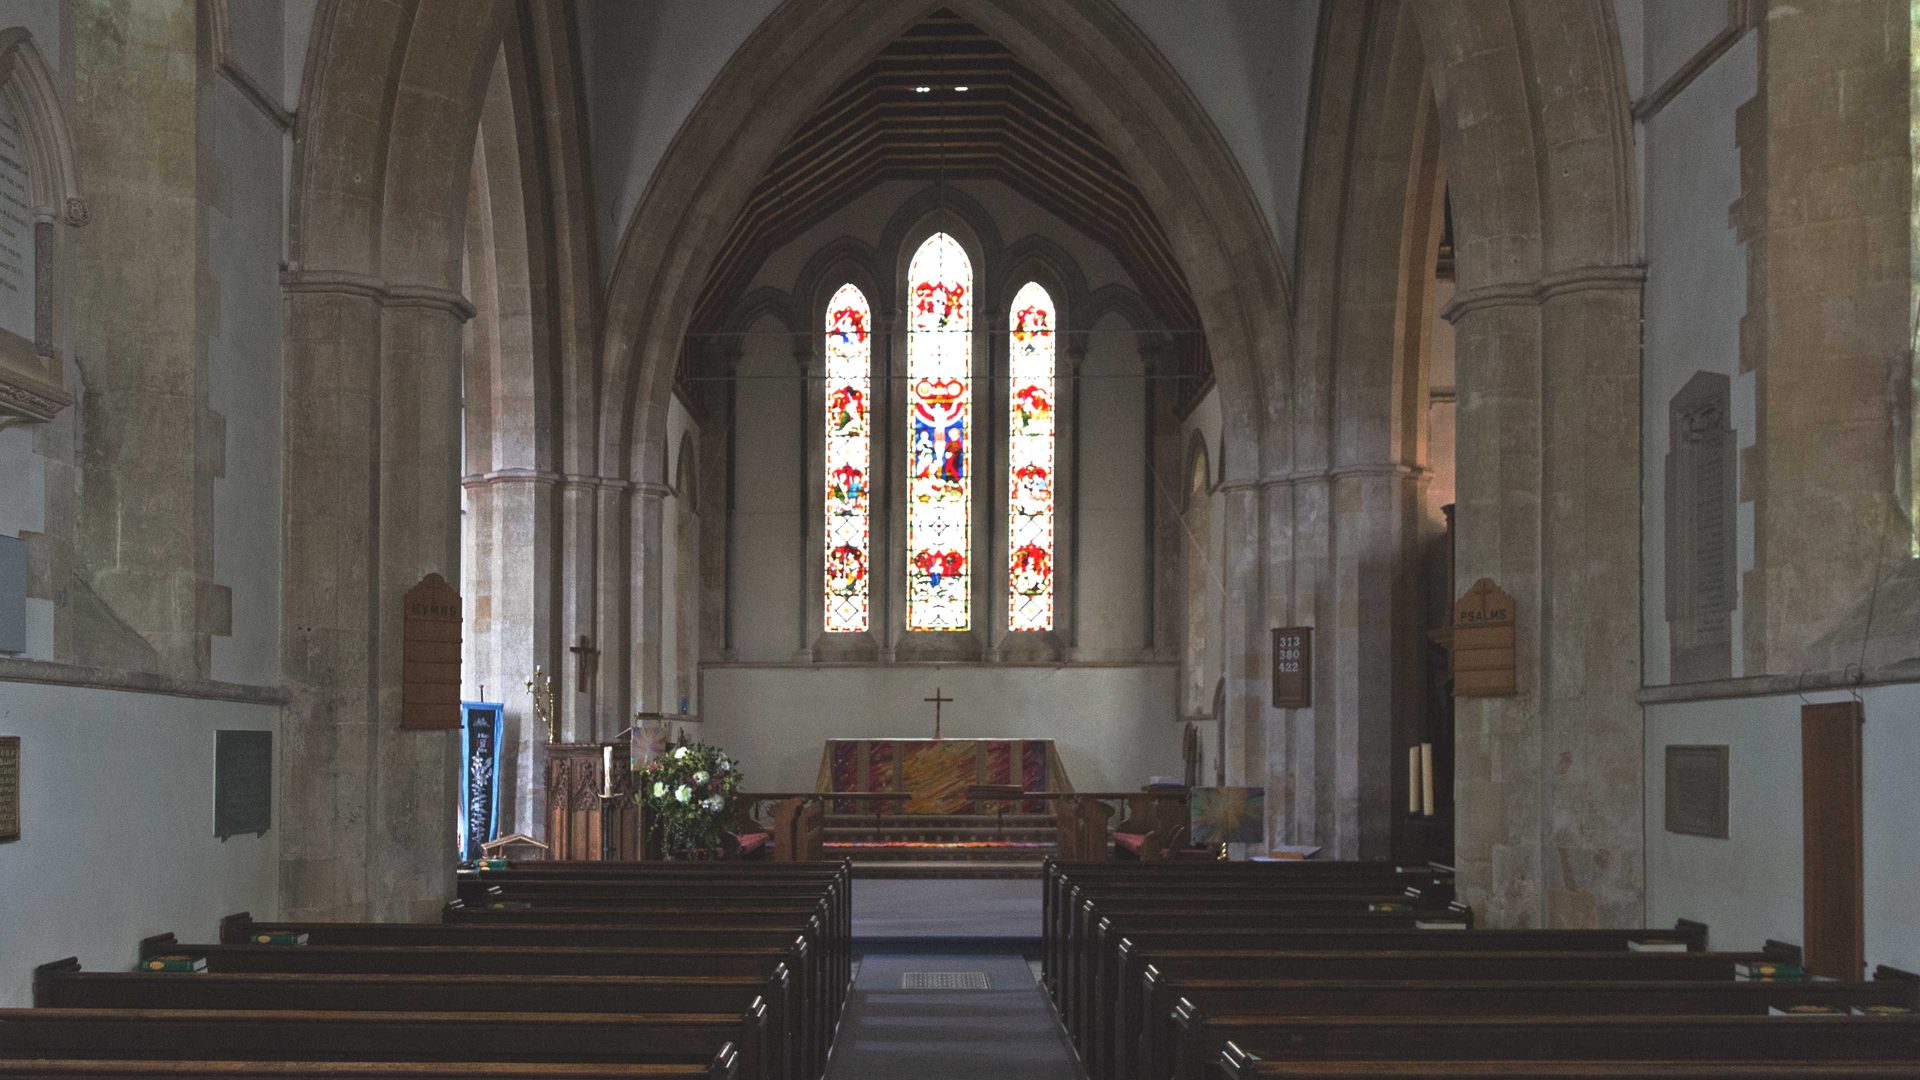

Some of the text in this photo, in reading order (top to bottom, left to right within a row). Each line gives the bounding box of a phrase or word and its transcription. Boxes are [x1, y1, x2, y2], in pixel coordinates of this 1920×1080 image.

[1460, 608, 1507, 622] PSALMS
[1280, 636, 1300, 647] 313
[1280, 649, 1300, 660] 380
[1279, 662, 1299, 672] 422
